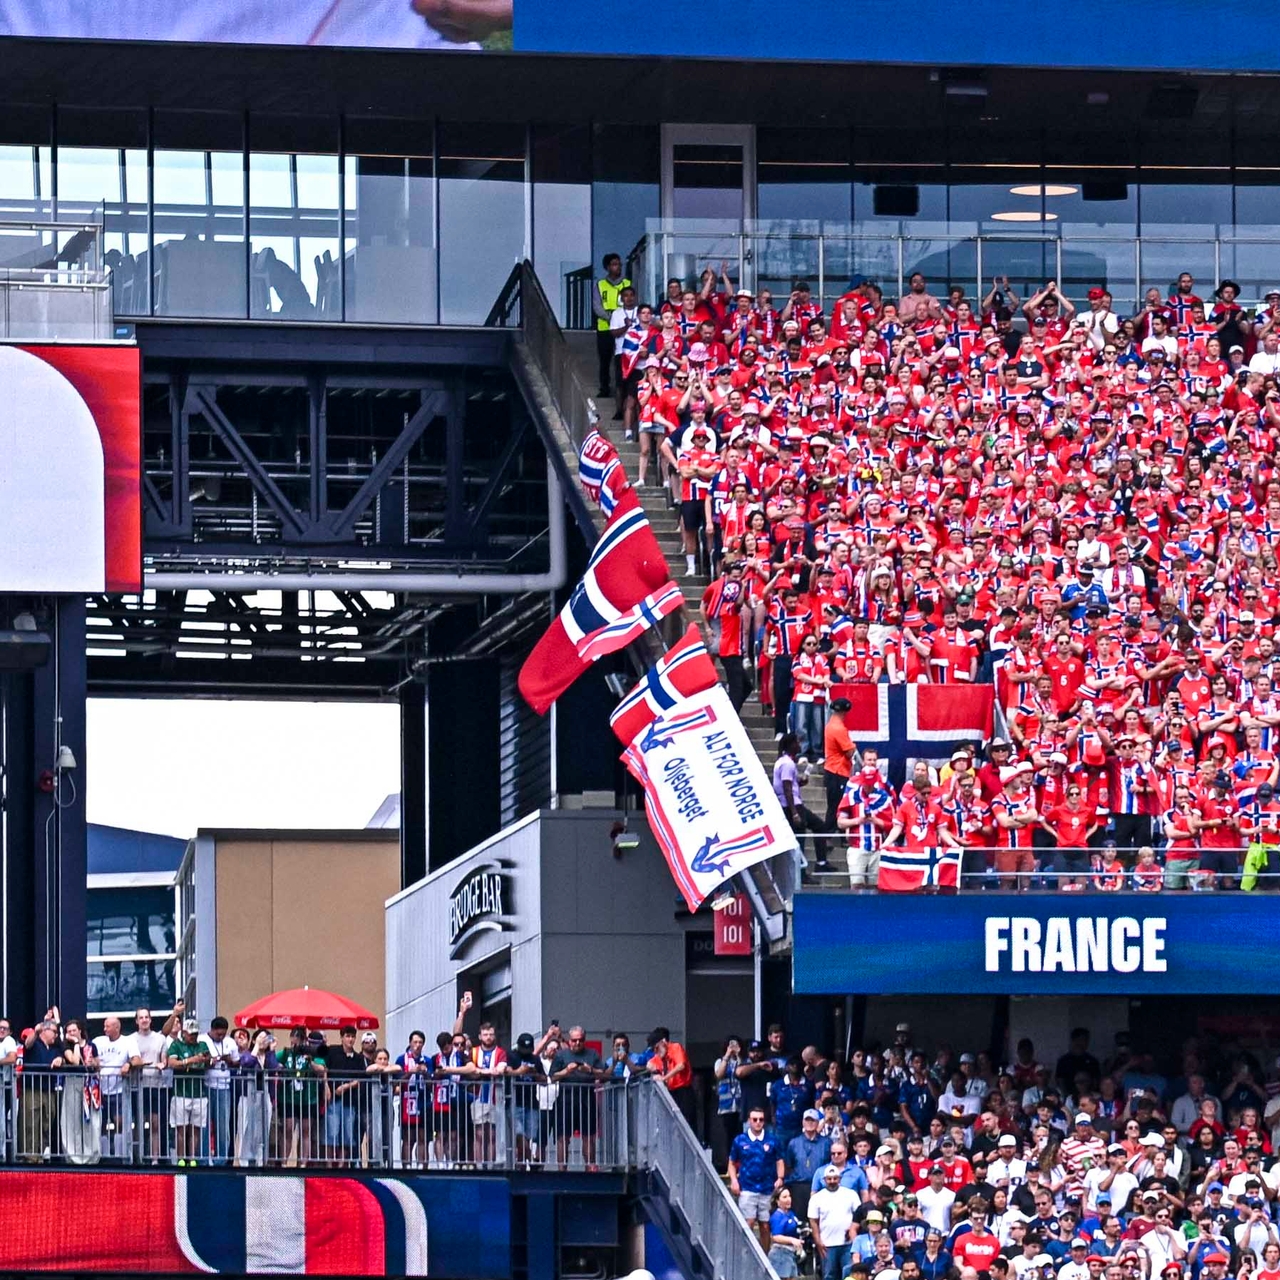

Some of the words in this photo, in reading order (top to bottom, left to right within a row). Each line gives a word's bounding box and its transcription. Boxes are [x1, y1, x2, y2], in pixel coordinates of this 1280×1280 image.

[702, 731, 732, 757] ALT
[716, 753, 744, 781] FOR
[730, 777, 764, 823] NORGE
[450, 875, 482, 944] BRIDGE
[482, 872, 502, 915] BAR
[723, 925, 742, 943] 101
[985, 916, 1167, 973] FRANCE
